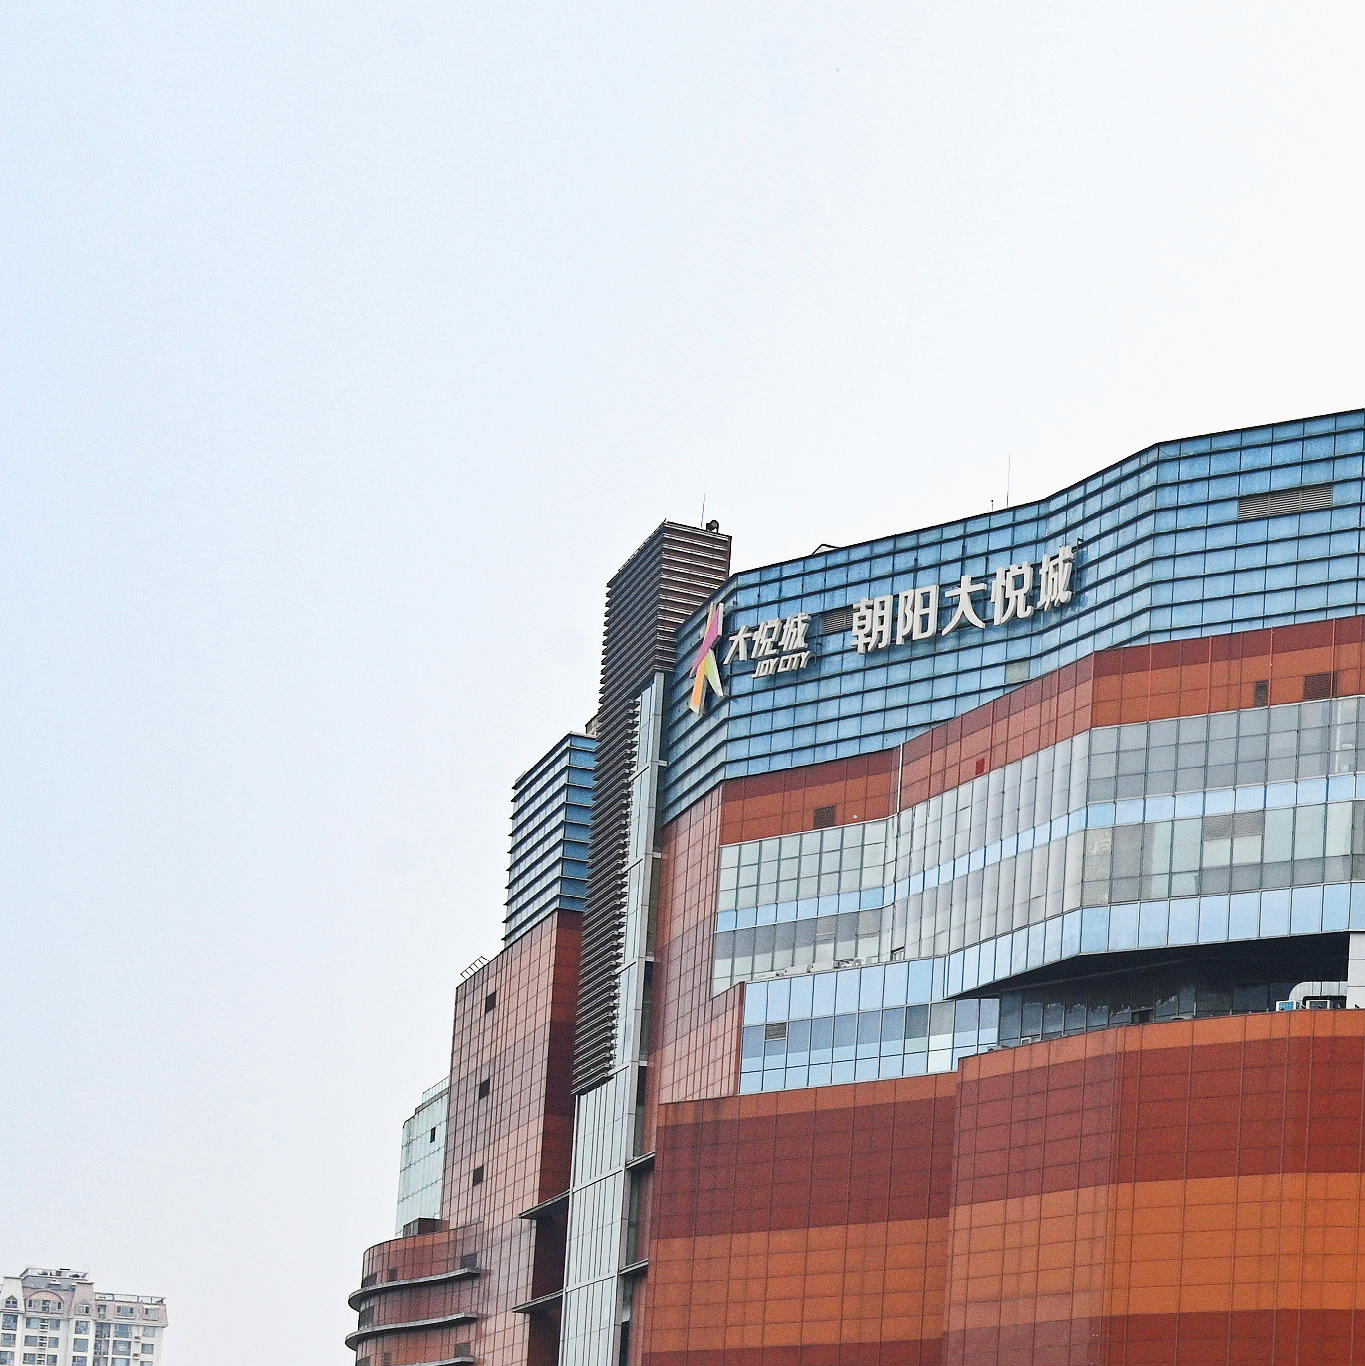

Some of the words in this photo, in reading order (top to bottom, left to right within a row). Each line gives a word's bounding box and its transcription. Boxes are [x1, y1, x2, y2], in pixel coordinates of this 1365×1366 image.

[851, 545, 1080, 654] 朝阳大悦城
[723, 612, 810, 665] 大悦城
[753, 655, 780, 679] JOY
[779, 651, 810, 673] CITY
